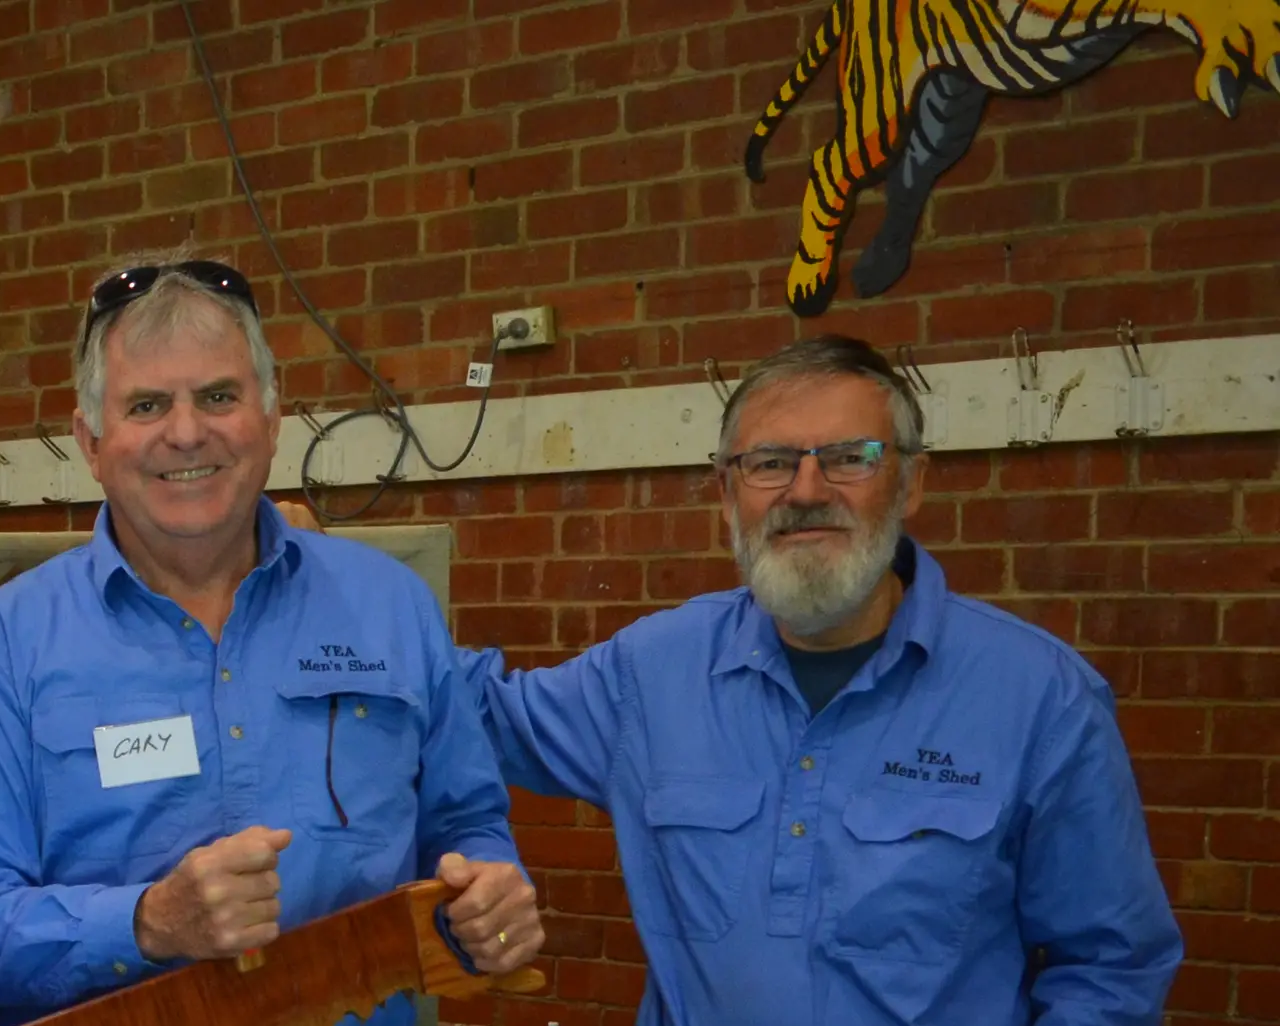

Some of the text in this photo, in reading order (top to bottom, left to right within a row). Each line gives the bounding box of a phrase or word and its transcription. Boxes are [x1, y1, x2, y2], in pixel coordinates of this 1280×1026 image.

[320, 644, 357, 658] YEA
[298, 658, 387, 672] Men's Shed
[916, 748, 955, 767] YEA
[881, 761, 982, 786] Men's Shed
